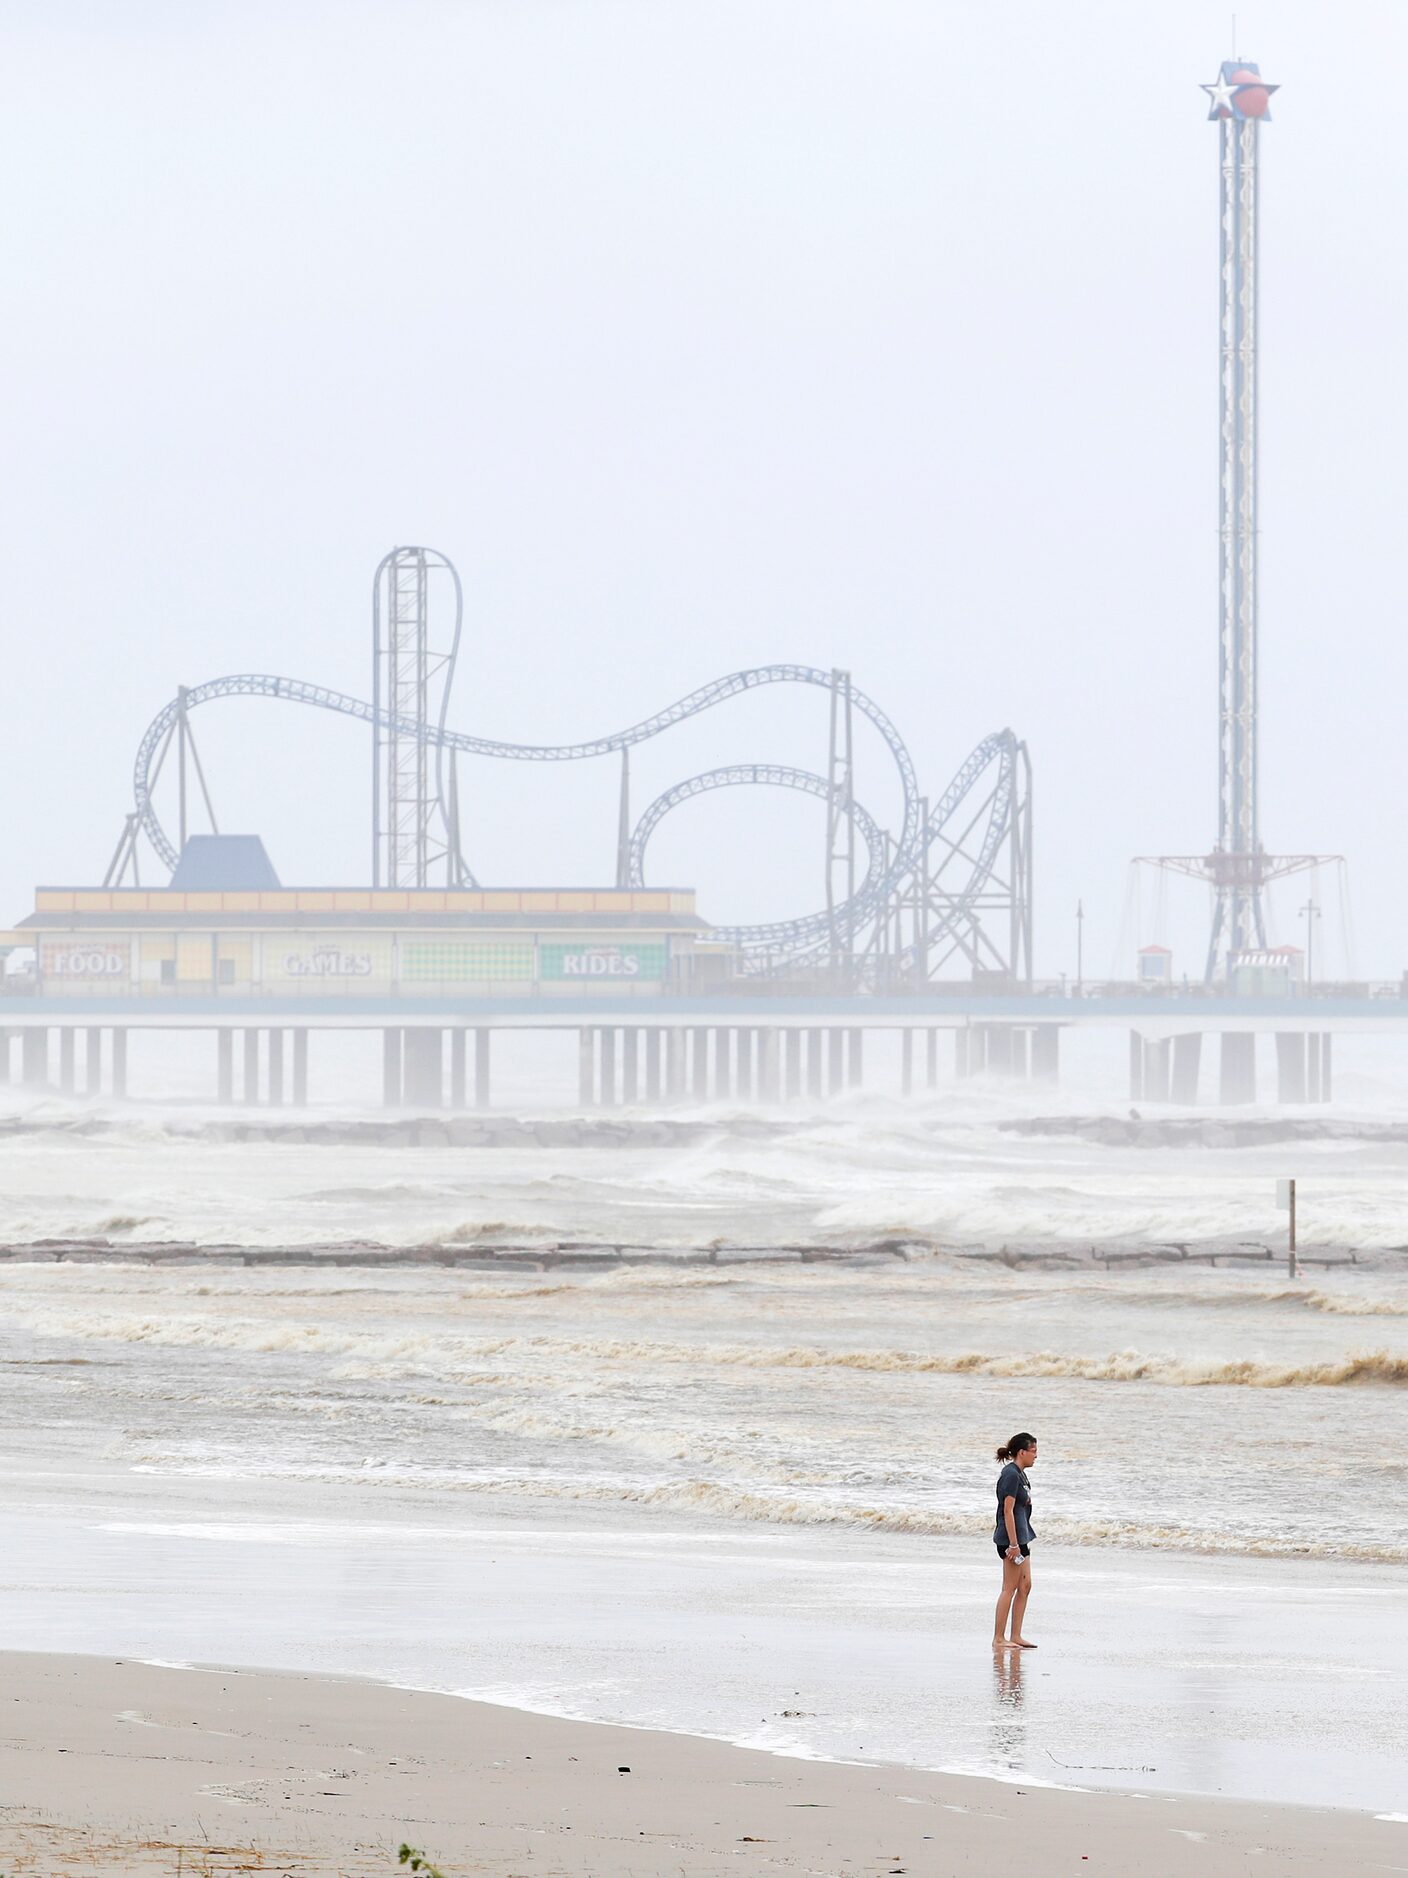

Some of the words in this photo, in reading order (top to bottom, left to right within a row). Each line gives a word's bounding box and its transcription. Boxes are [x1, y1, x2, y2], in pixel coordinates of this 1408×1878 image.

[54, 953, 123, 974] FOOD
[282, 953, 371, 976] GAMES
[563, 954, 639, 975] RIDES
